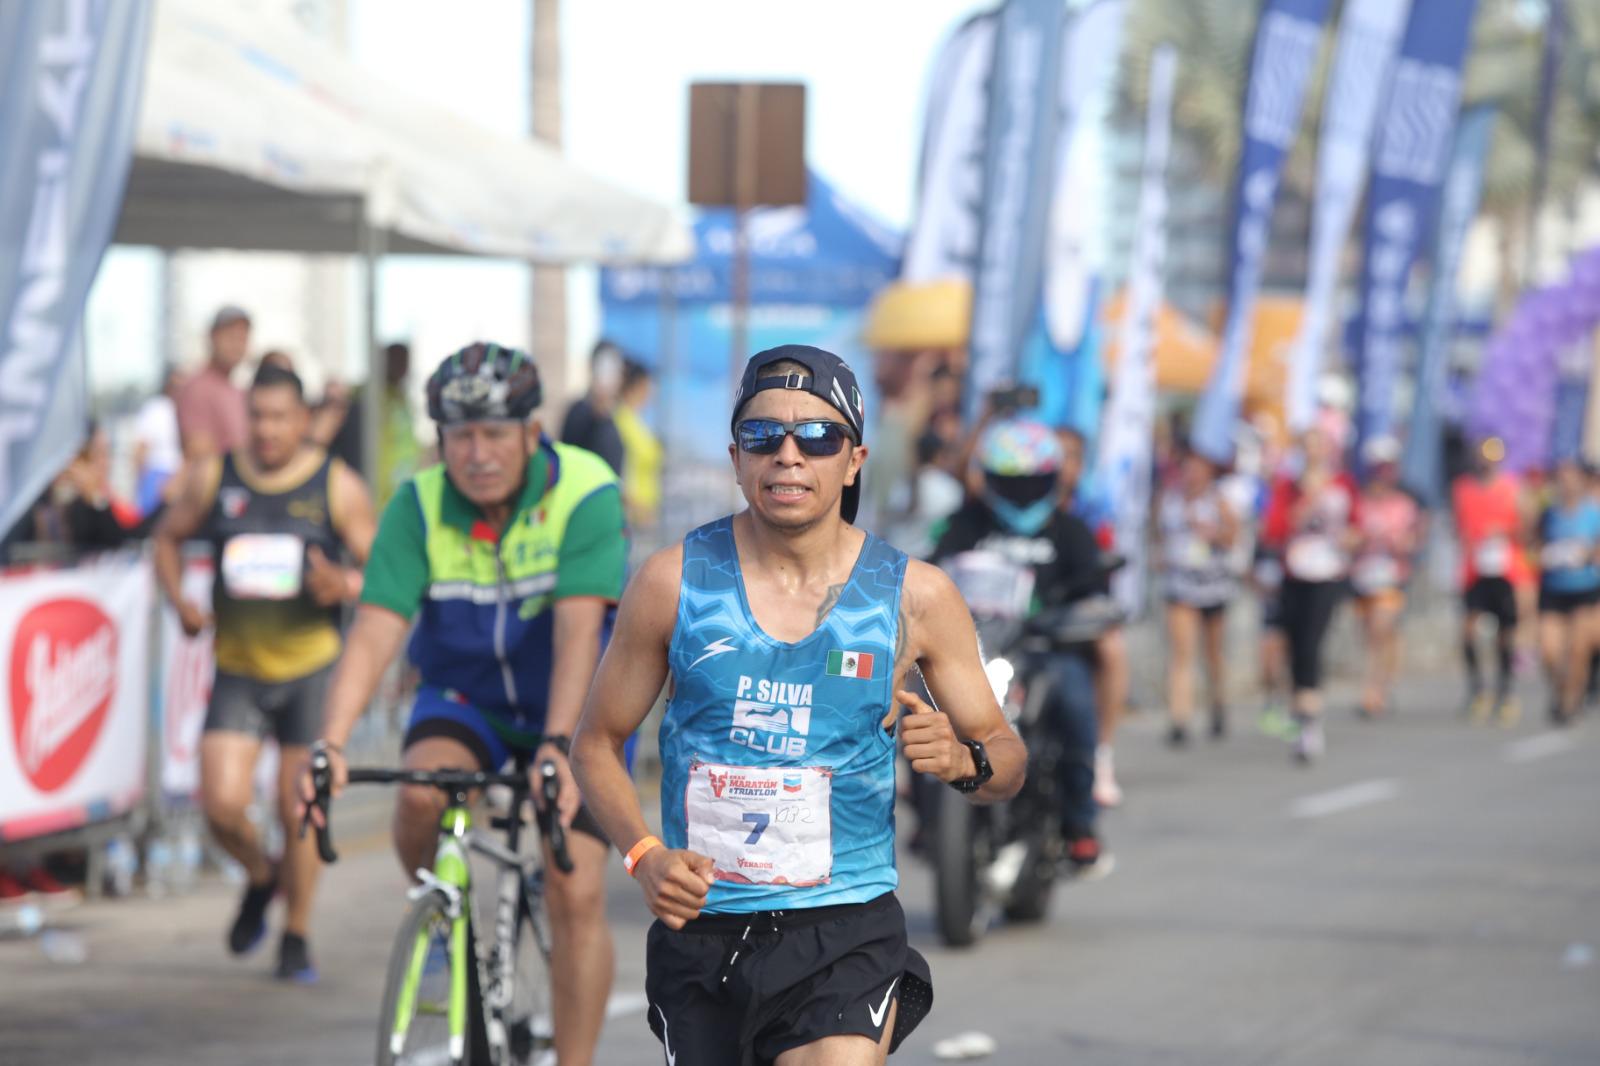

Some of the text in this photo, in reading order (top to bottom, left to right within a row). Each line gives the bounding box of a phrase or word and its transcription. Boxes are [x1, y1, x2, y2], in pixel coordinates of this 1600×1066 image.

[736, 675, 813, 706] P. SILVA
[729, 727, 807, 757] CLUB
[742, 813, 770, 845] 7
